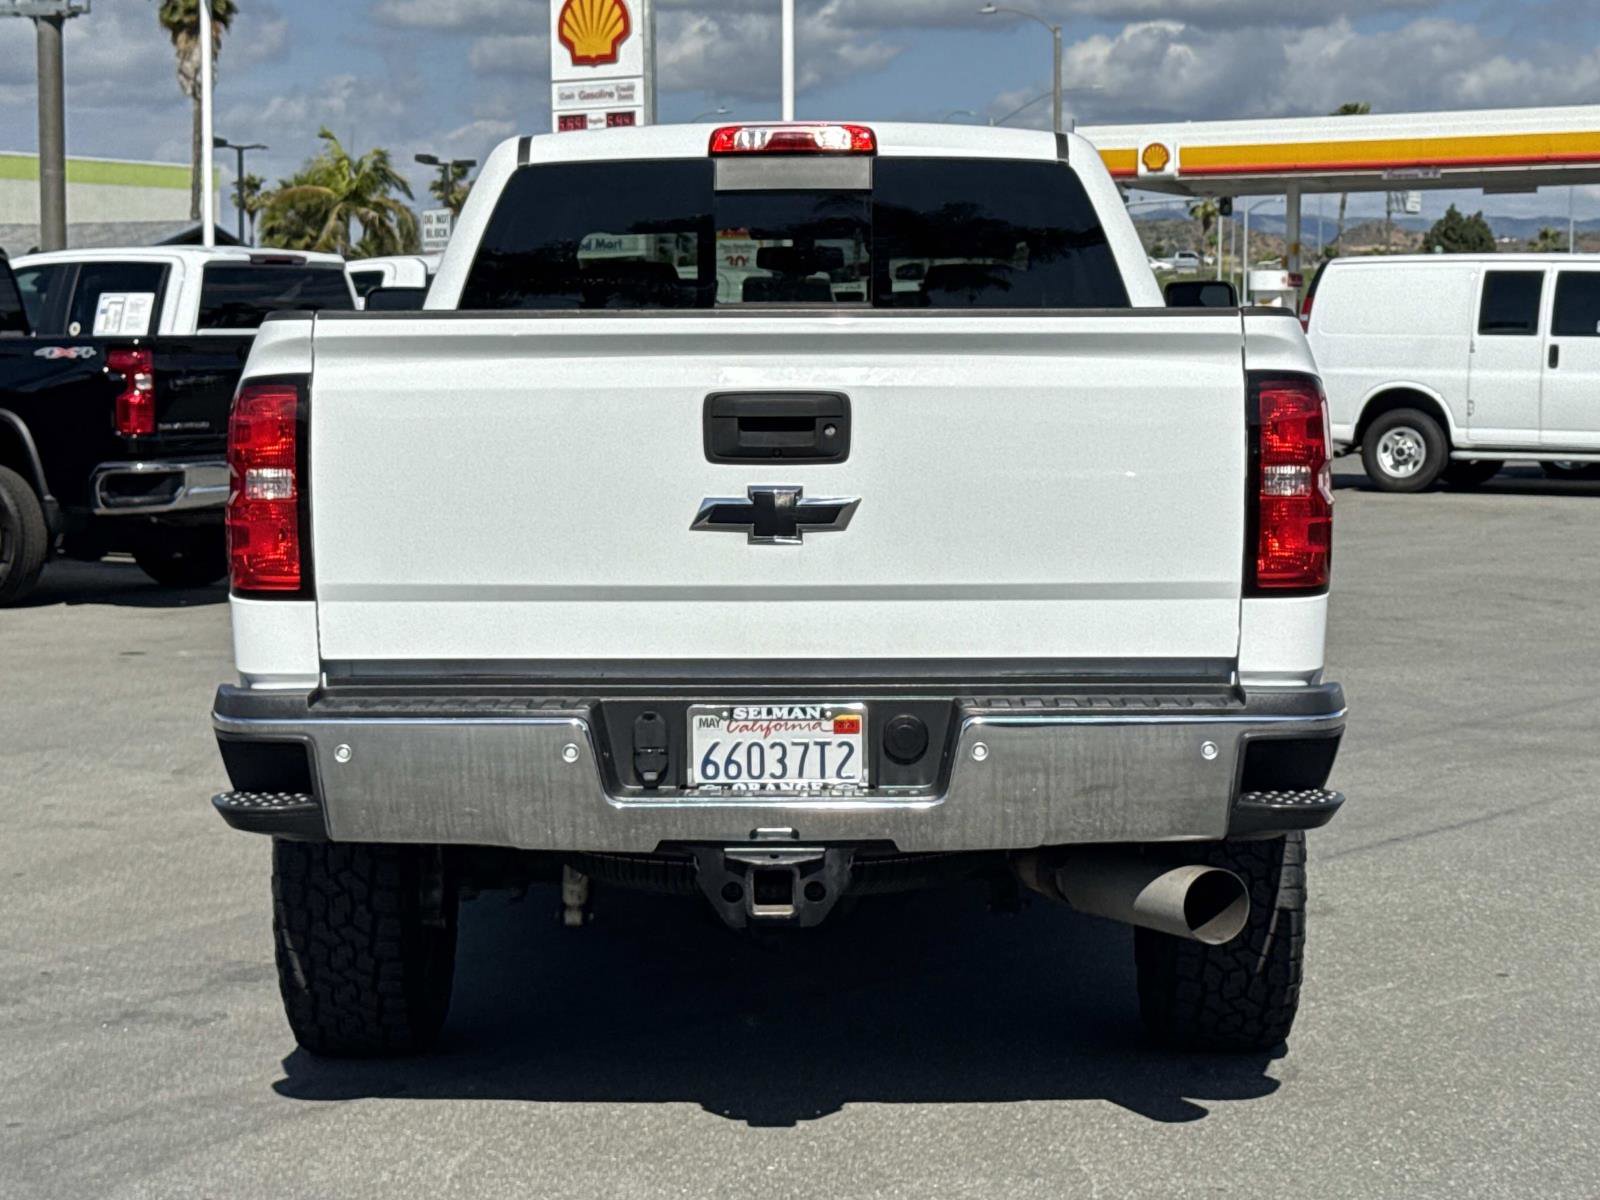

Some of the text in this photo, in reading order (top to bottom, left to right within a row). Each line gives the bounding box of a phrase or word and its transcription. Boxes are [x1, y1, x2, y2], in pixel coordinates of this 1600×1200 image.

[578, 89, 615, 101] Gasoline
[732, 706, 822, 720] SELMAN
[699, 717, 721, 729] MAY
[726, 720, 834, 739] California
[700, 740, 856, 780] 66037T2
